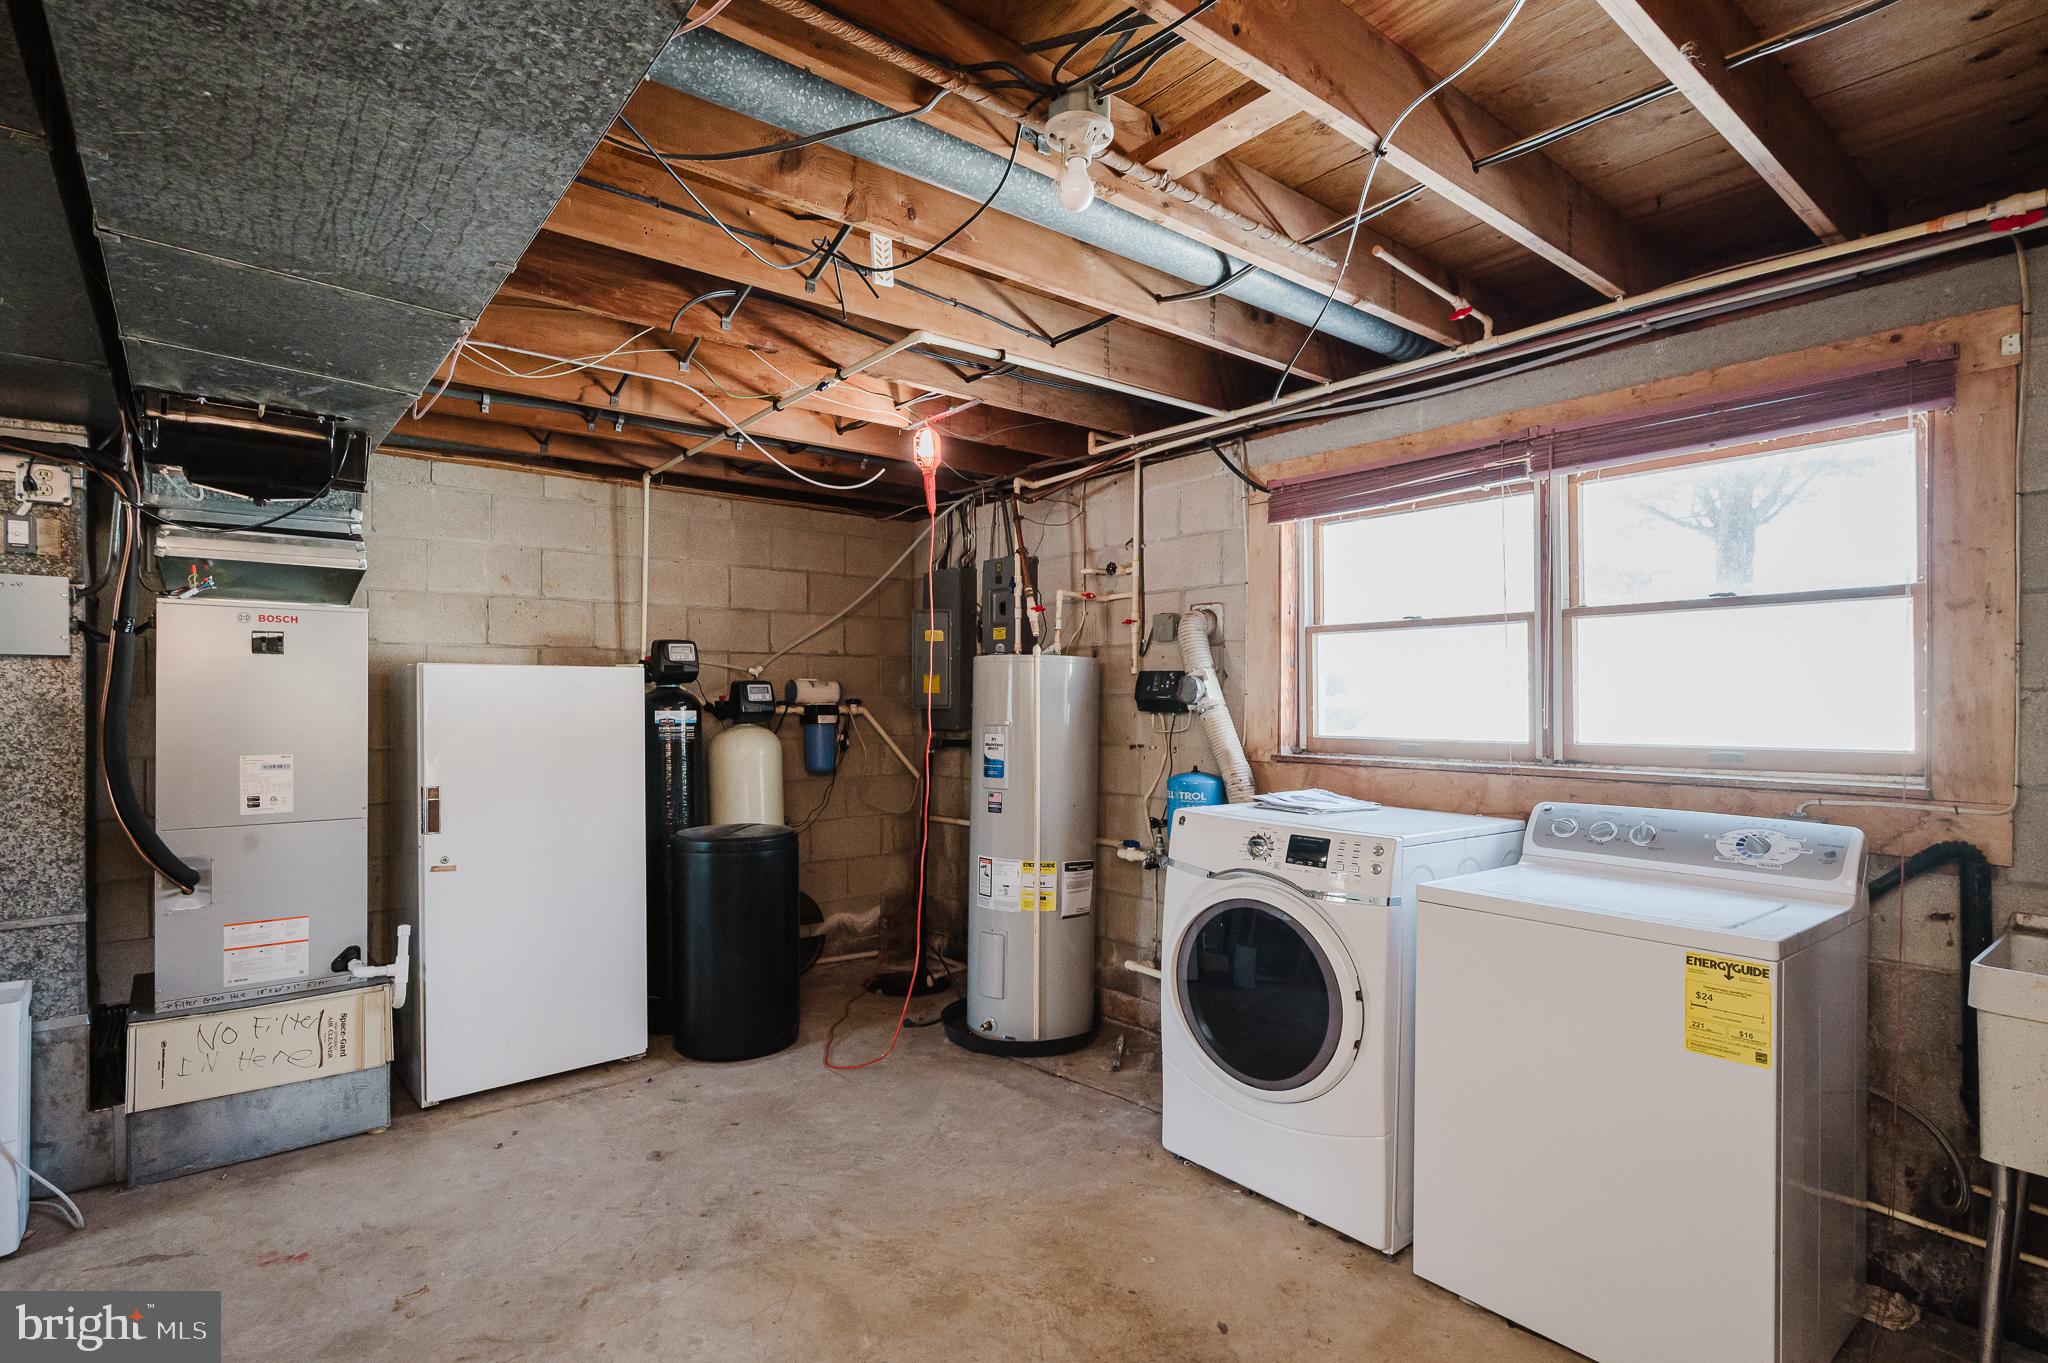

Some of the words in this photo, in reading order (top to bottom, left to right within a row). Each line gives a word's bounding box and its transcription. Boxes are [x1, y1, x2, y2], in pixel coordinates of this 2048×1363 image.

[258, 614, 299, 624] BOSCH
[1686, 955, 1770, 980] ENERGYGUIDE
[1695, 991, 1713, 1001] $24
[1691, 1020, 1705, 1029] 221
[1739, 1031, 1754, 1039] $16
